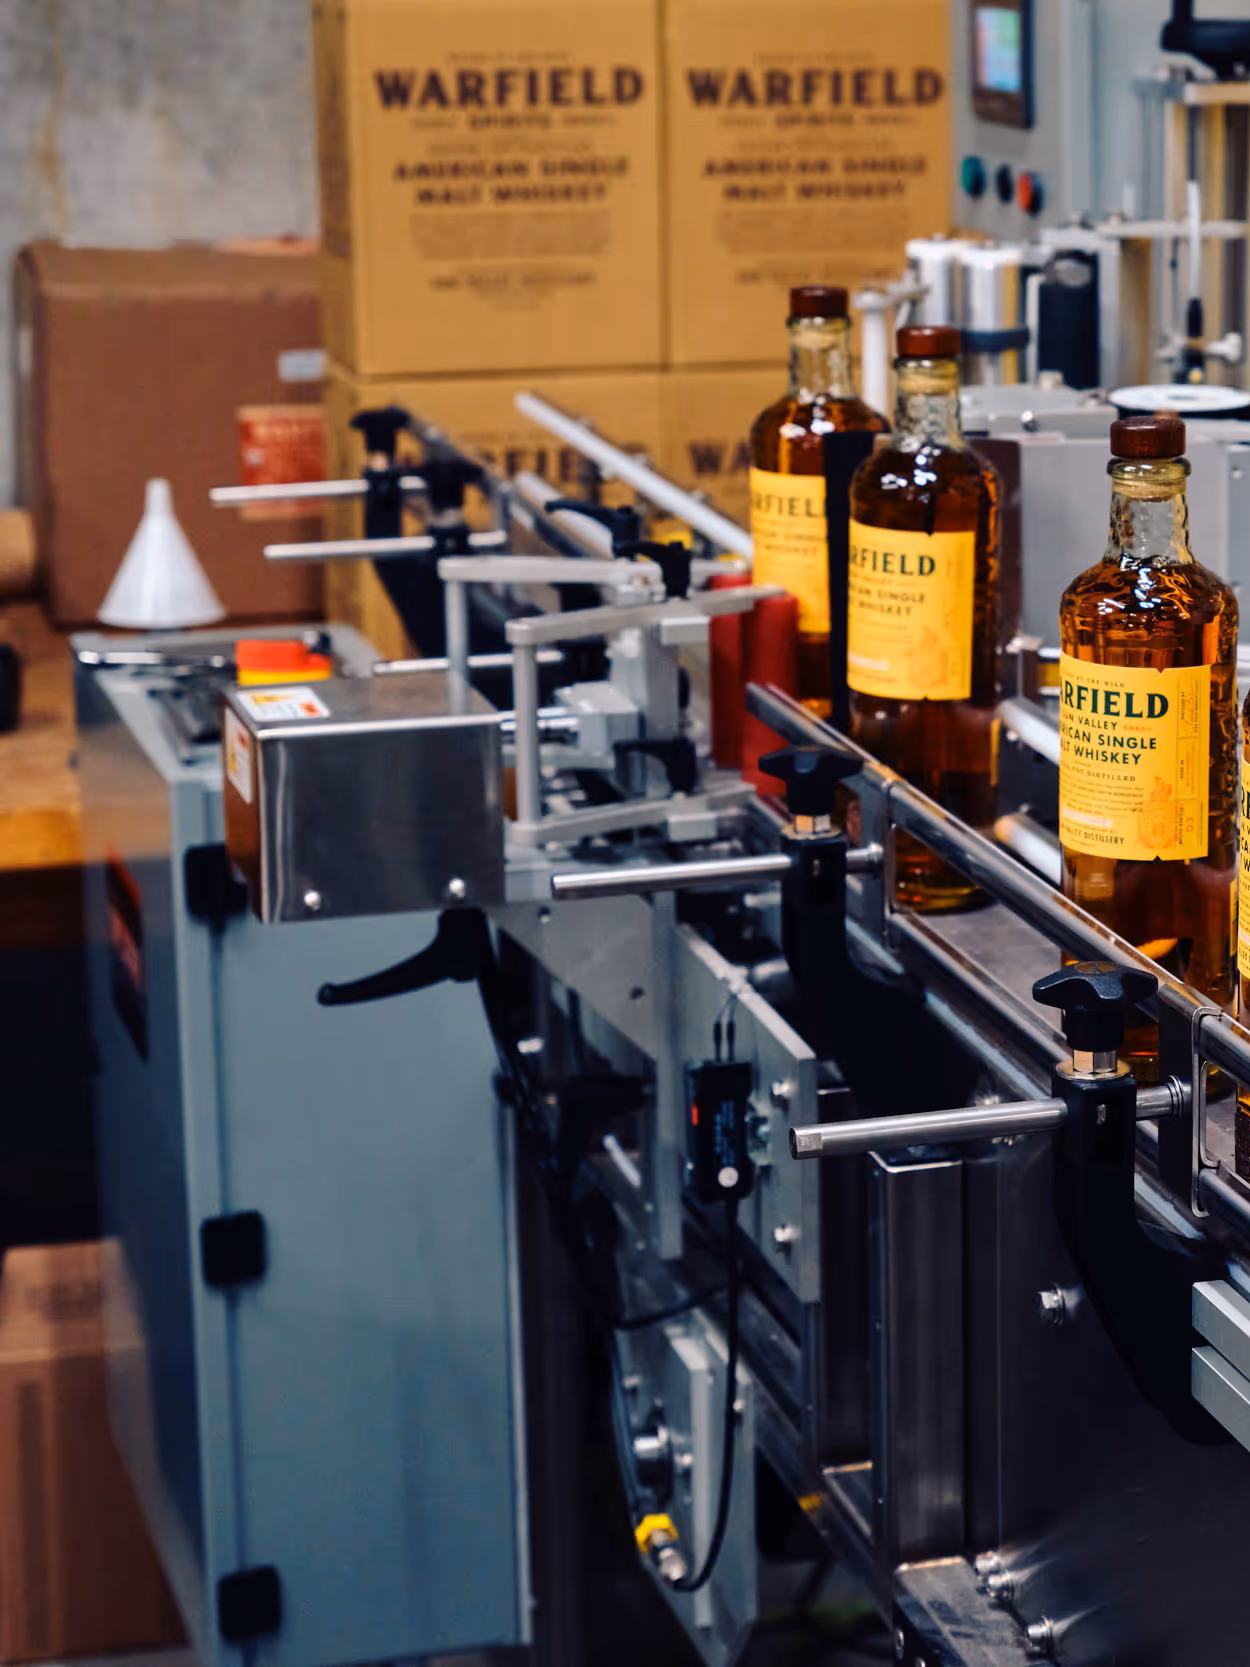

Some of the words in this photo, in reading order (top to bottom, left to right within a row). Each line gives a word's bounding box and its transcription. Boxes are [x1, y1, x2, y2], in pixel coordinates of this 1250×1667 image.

[374, 66, 644, 109] WARFIELD
[686, 66, 943, 109] WARFIELD
[1061, 680, 1169, 719] RFIELD
[1078, 715, 1118, 731] VALLEY
[1098, 734, 1157, 750] SINGLE
[1074, 744, 1142, 765] WHISKEY
[1084, 830, 1125, 845] DISTILLERY
